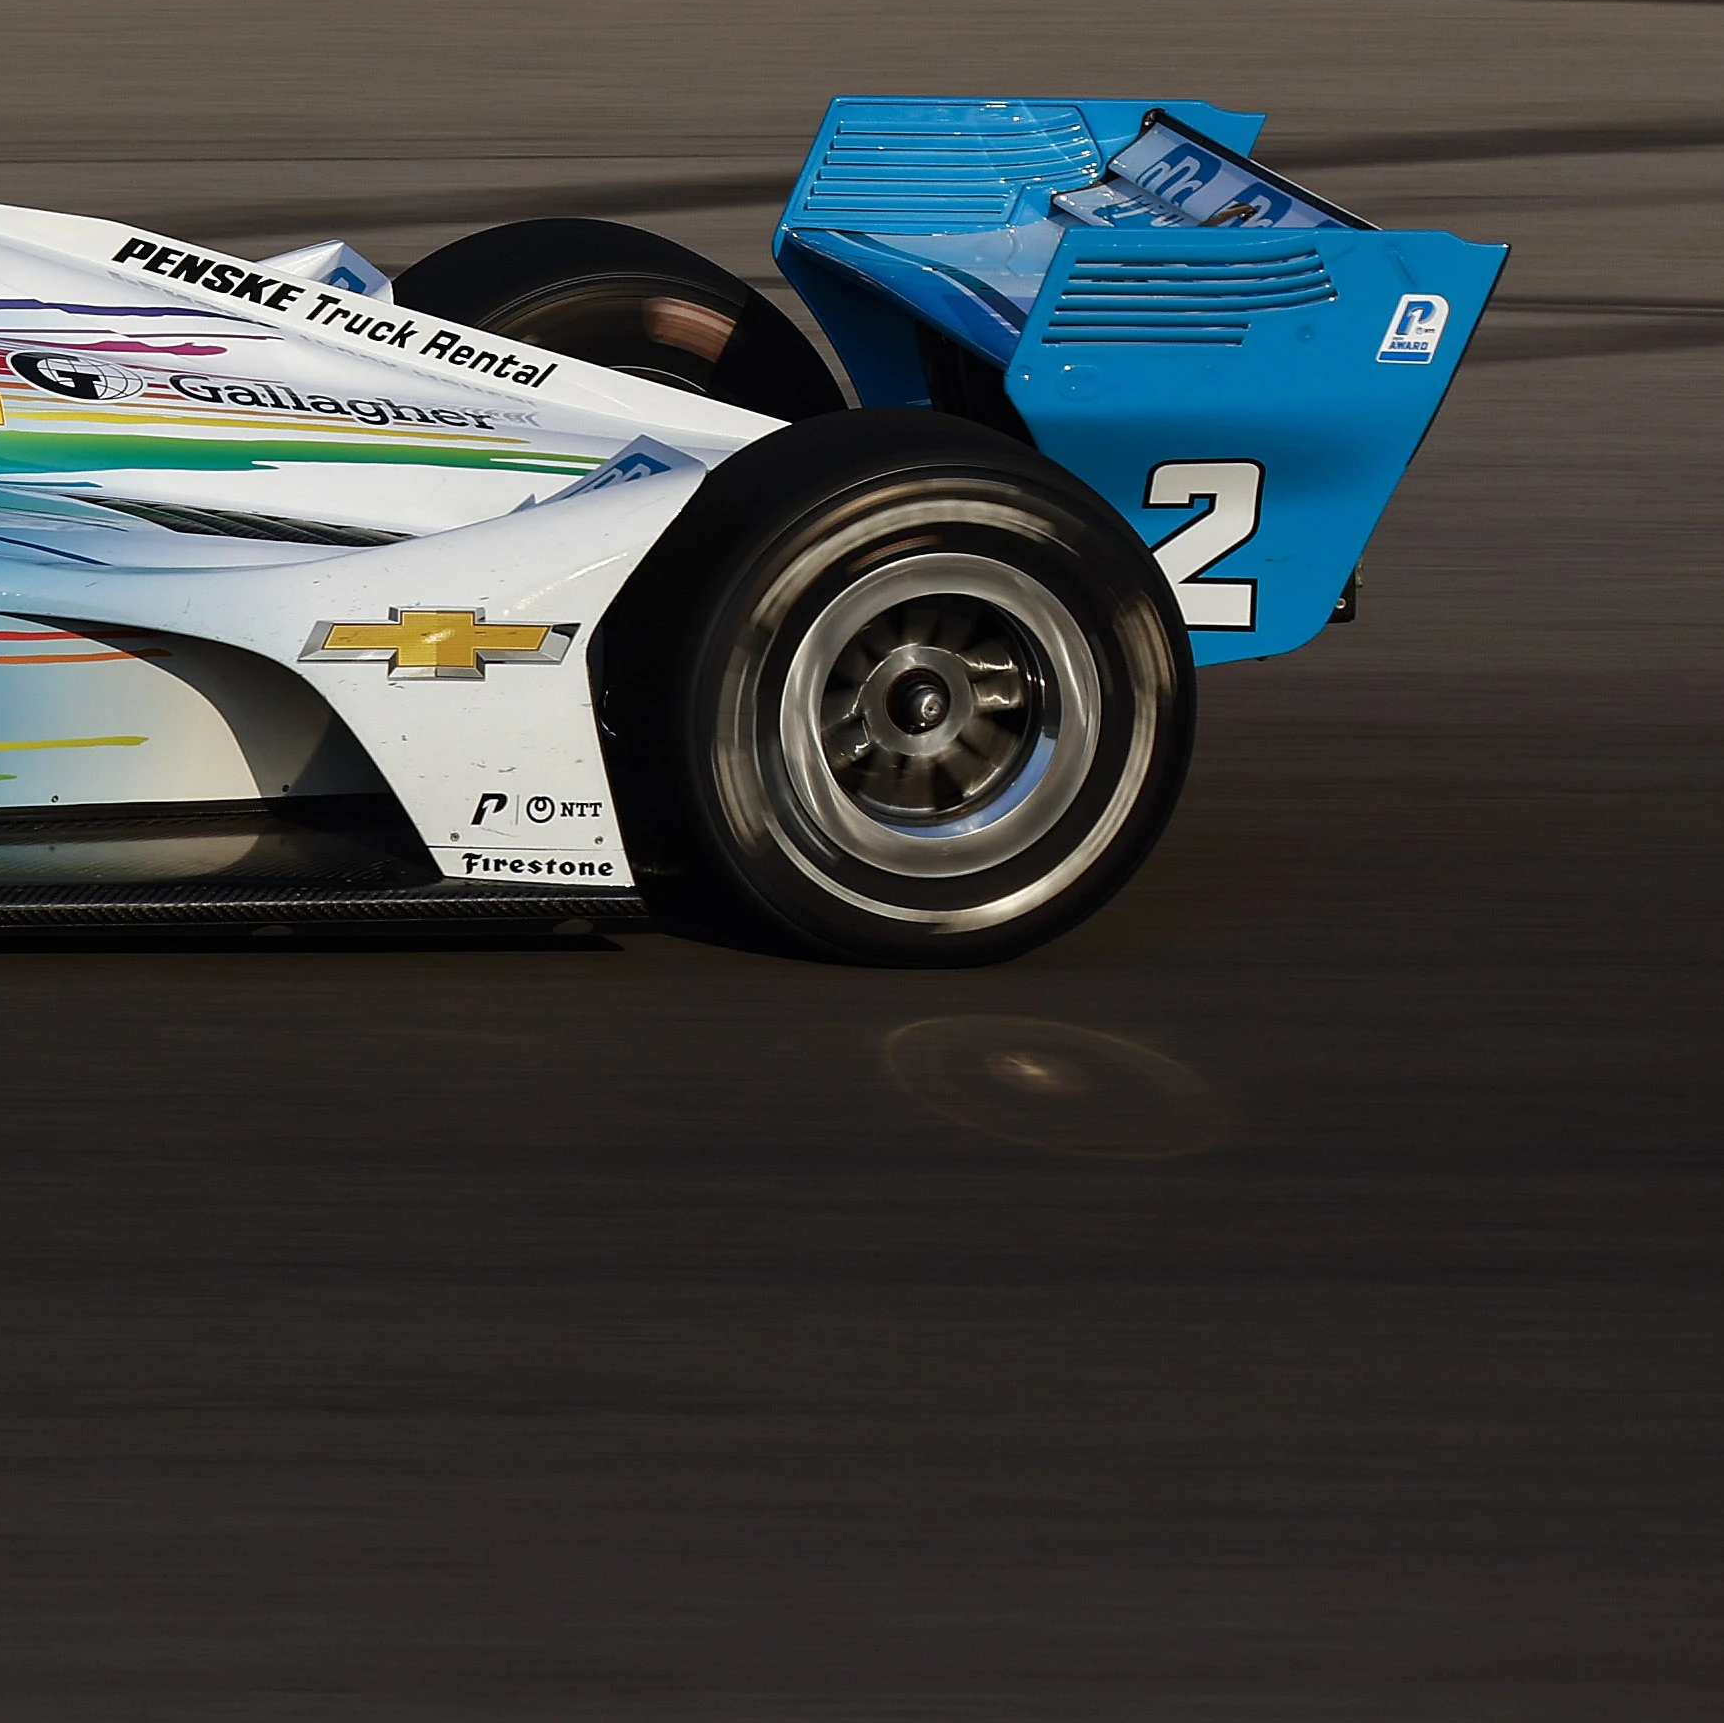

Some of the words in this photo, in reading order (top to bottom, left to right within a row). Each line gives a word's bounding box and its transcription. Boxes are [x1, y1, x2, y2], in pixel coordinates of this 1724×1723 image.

[111, 237, 306, 311] PENSKE
[305, 293, 418, 349] Truck
[419, 330, 559, 388] Rental
[1388, 341, 1429, 351] AWARD
[169, 375, 495, 430] Gallagher
[1142, 458, 1265, 632] 2
[560, 802, 602, 817] NTT
[462, 853, 613, 876] Firestone
